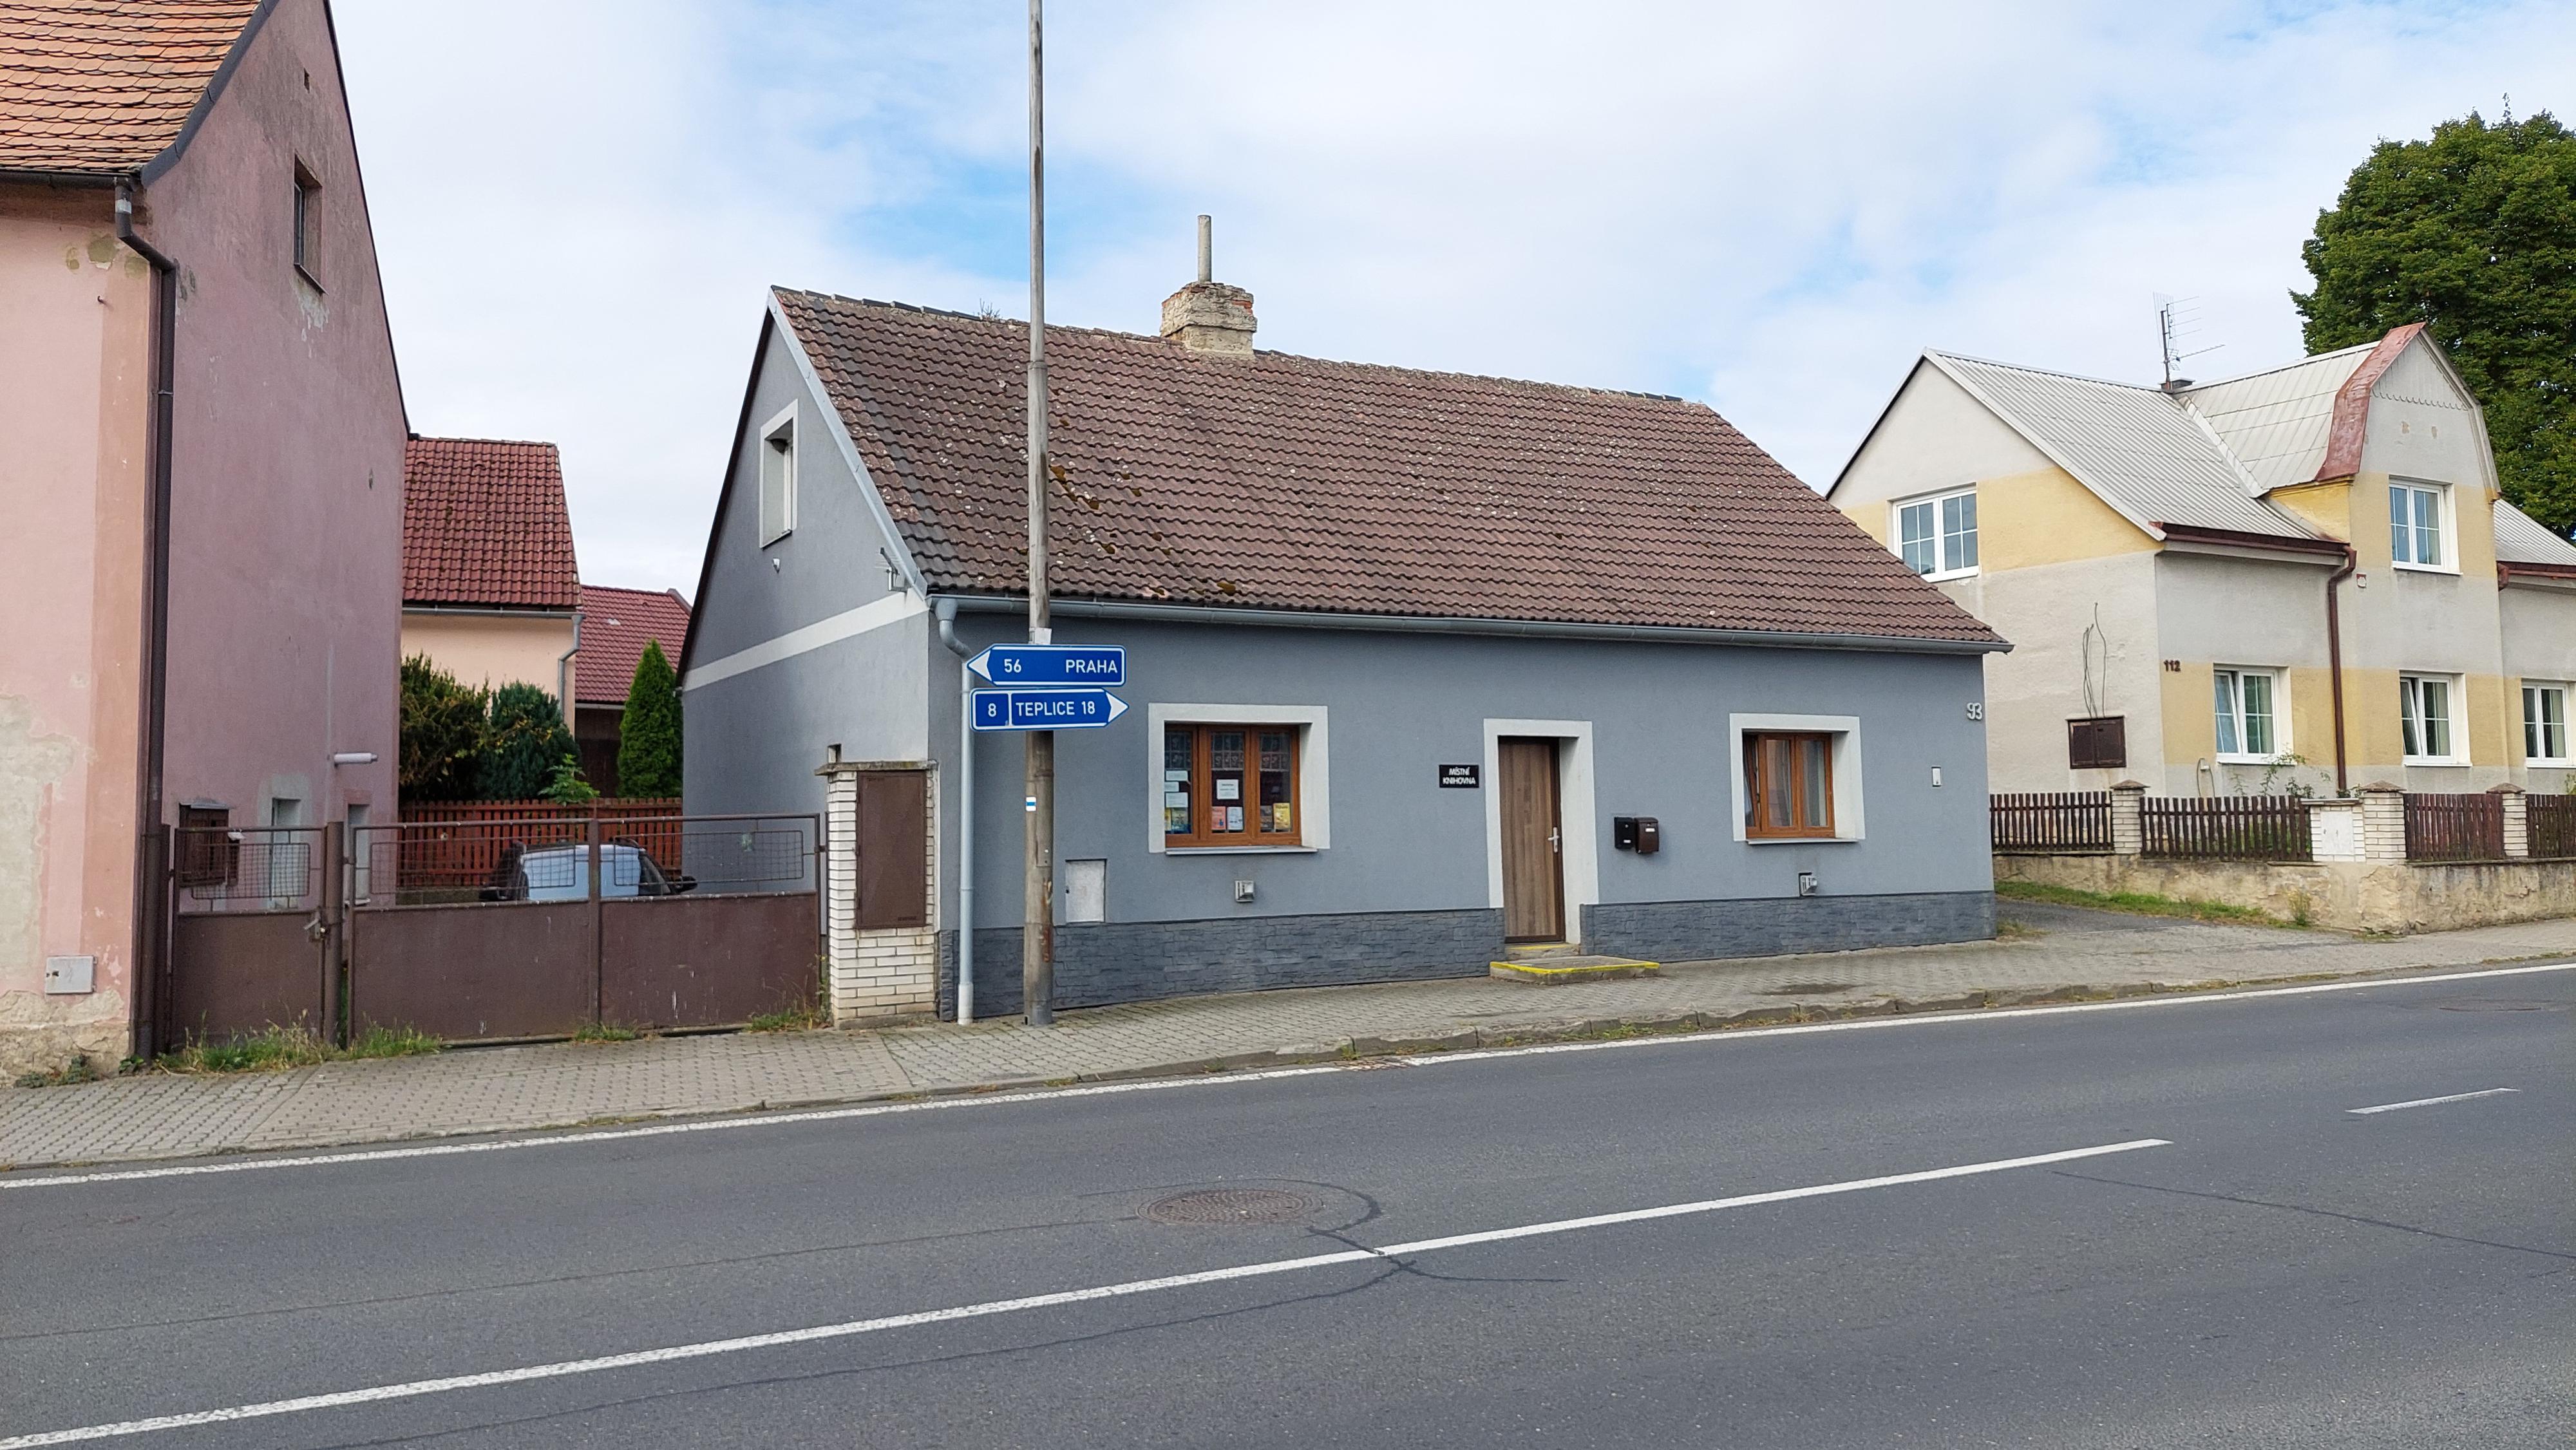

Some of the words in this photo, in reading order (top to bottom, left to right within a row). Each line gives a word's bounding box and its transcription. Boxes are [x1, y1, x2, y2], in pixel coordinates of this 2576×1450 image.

[1004, 659, 1022, 673] 56
[1066, 659, 1118, 673] PRAHA
[2164, 660, 2181, 672] 112
[988, 703, 997, 717] 8
[1016, 702, 1075, 716] TEPLICE
[1081, 701, 1095, 715] 18
[1967, 702, 1982, 720] 93
[1449, 767, 1470, 775] MÍSTNÍ
